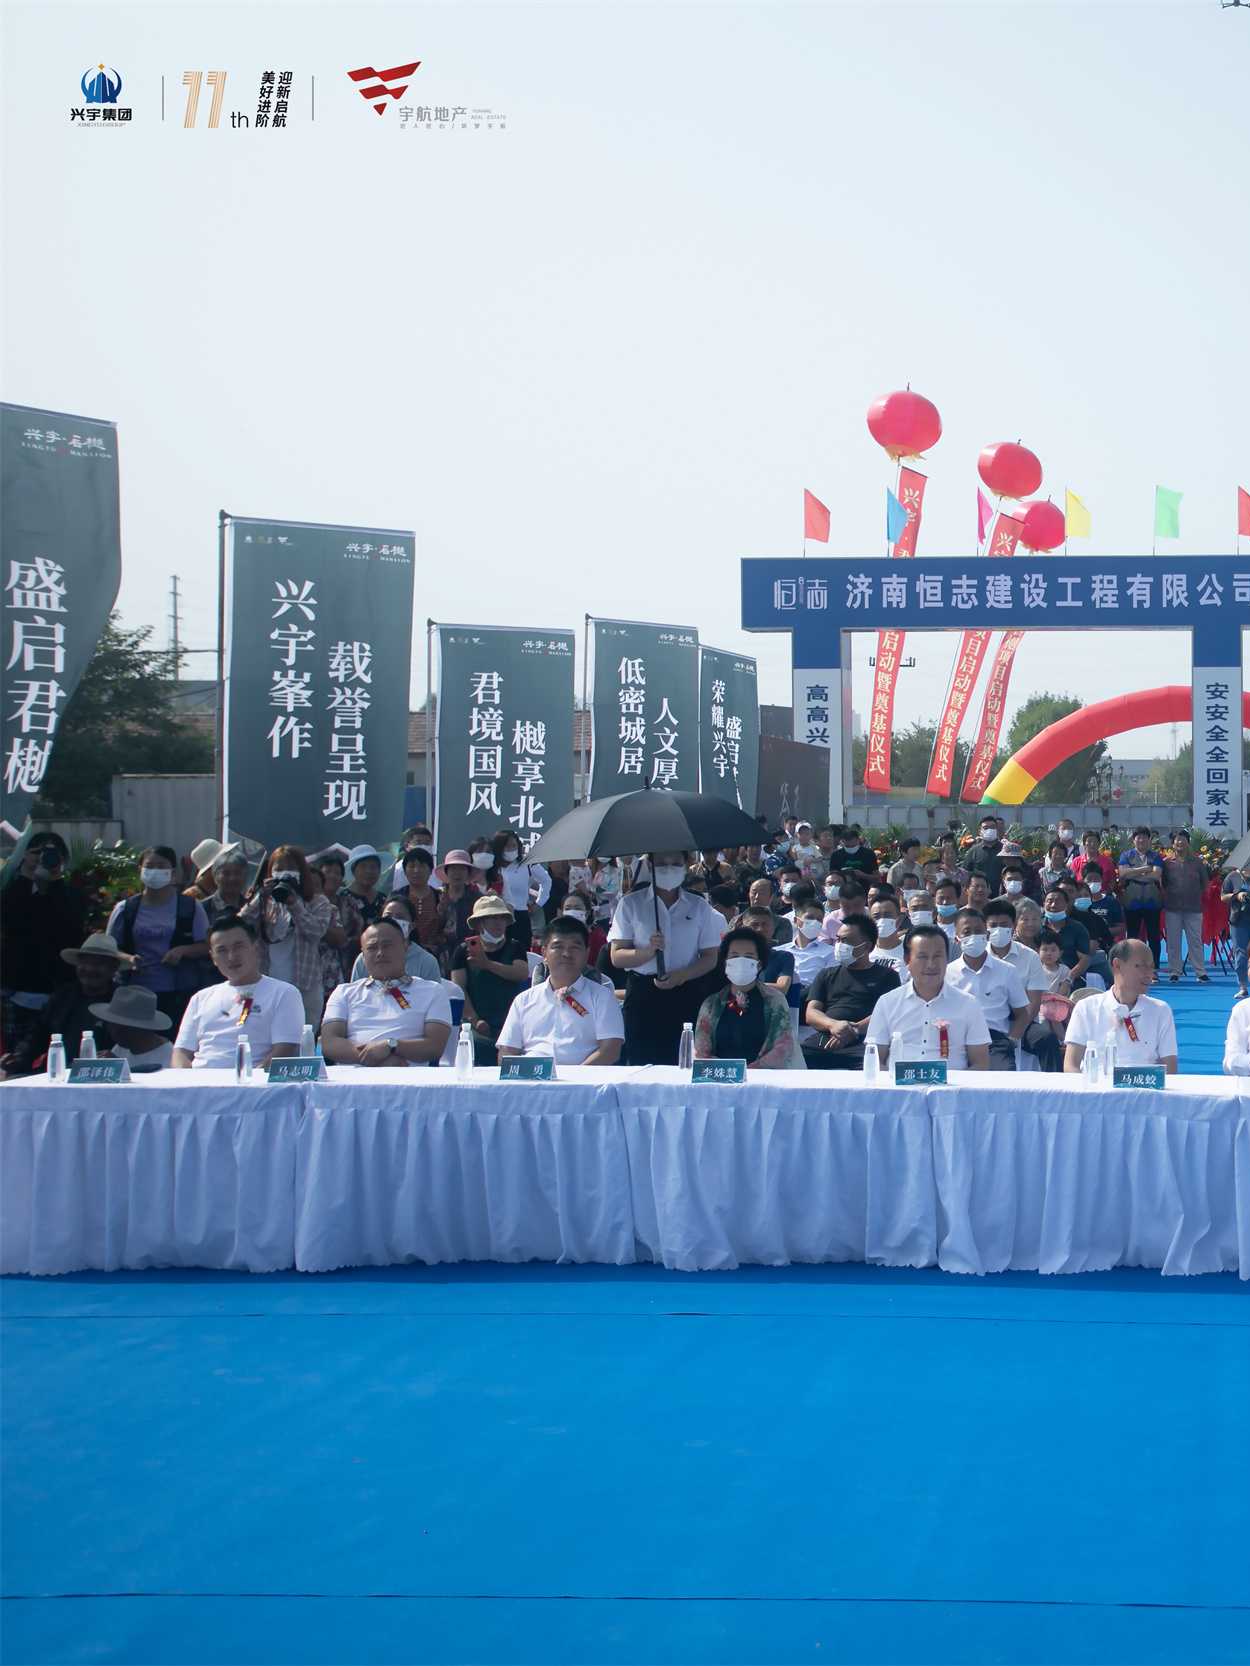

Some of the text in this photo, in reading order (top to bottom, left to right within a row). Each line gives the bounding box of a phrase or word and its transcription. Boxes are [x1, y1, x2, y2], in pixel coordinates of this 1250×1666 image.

[322, 640, 372, 821] 载誉呈现
[466, 671, 504, 816] 君境国风
[617, 657, 646, 775] 低密城居
[651, 698, 679, 791] 人文厚
[711, 679, 729, 778] 荣耀兴宇
[805, 684, 830, 744] 高高兴
[870, 631, 899, 775] 启动暨奠基仪式
[1205, 682, 1231, 828] 安安全全回家去
